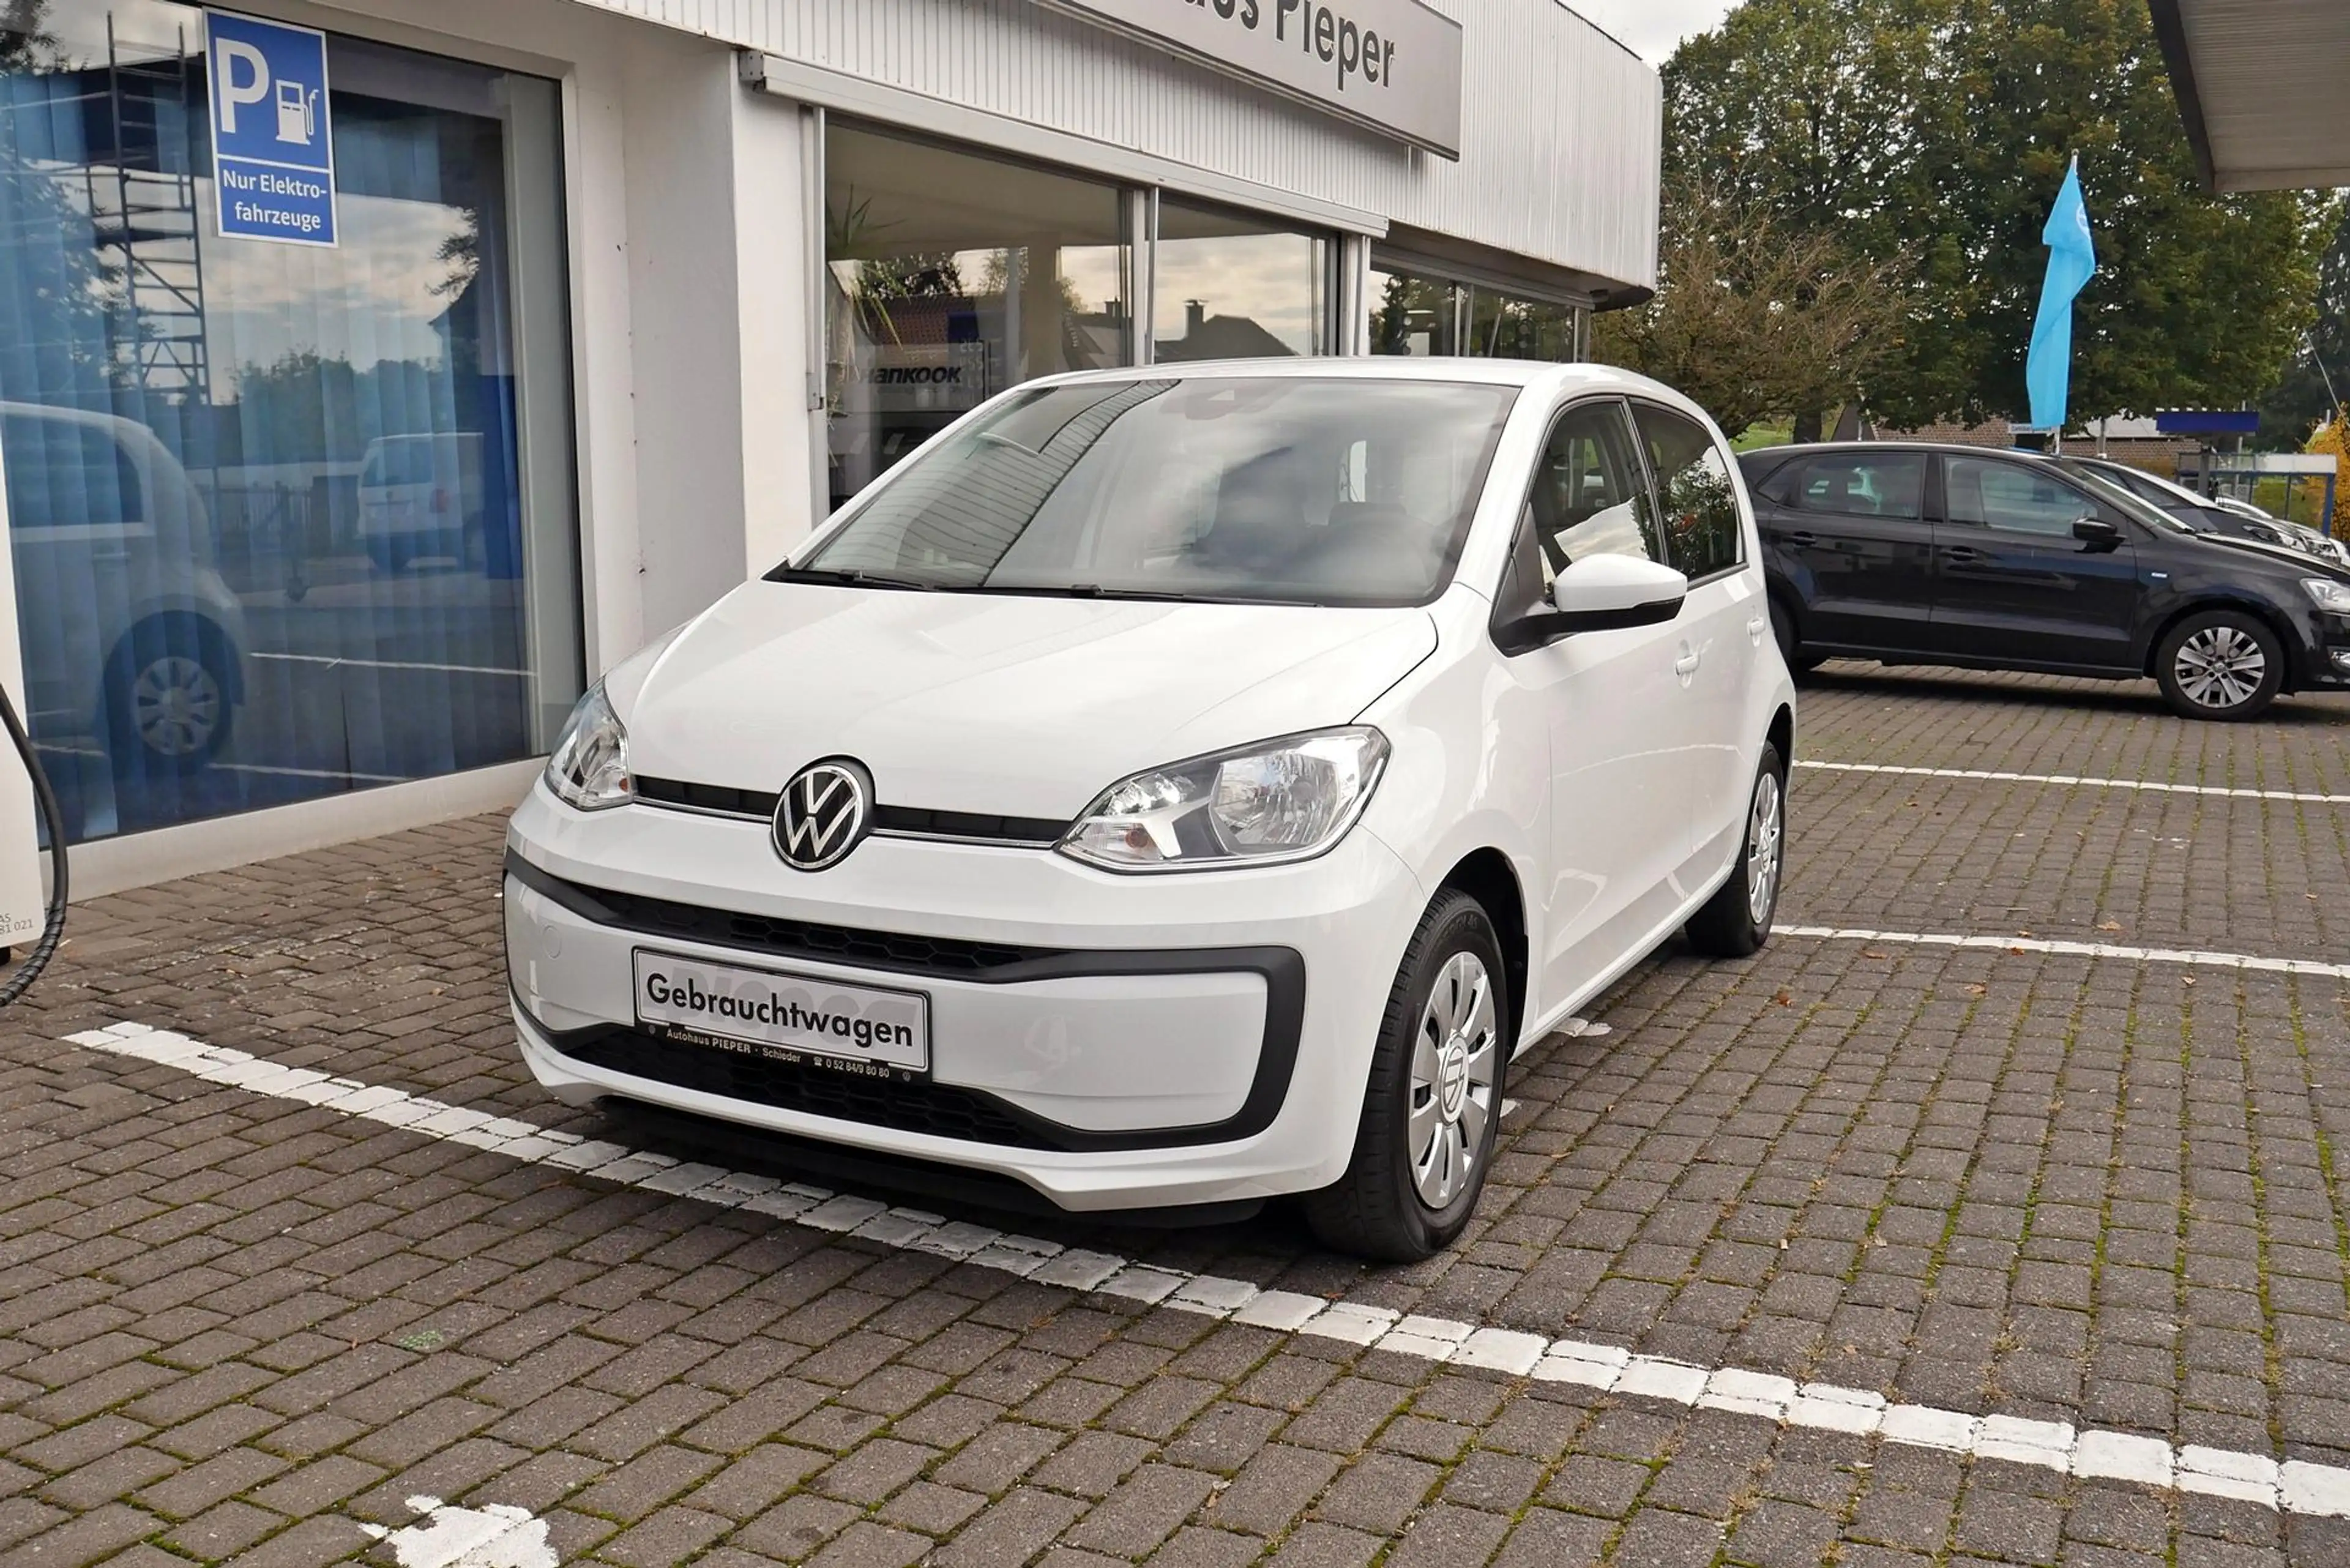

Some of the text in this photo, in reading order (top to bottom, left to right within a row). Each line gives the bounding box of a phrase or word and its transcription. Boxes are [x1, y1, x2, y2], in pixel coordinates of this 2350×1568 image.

[1276, 0, 1395, 91] Pieper
[215, 37, 269, 133] P
[222, 169, 327, 198] Nur Elektro-
[235, 201, 321, 232] fahrzeuge
[13, 918, 33, 931] 021
[647, 973, 912, 1048] Gebrauchtwagen
[666, 1029, 709, 1045] Autohaus
[712, 1038, 751, 1053] PIEPER
[763, 1047, 801, 1062] Schieder
